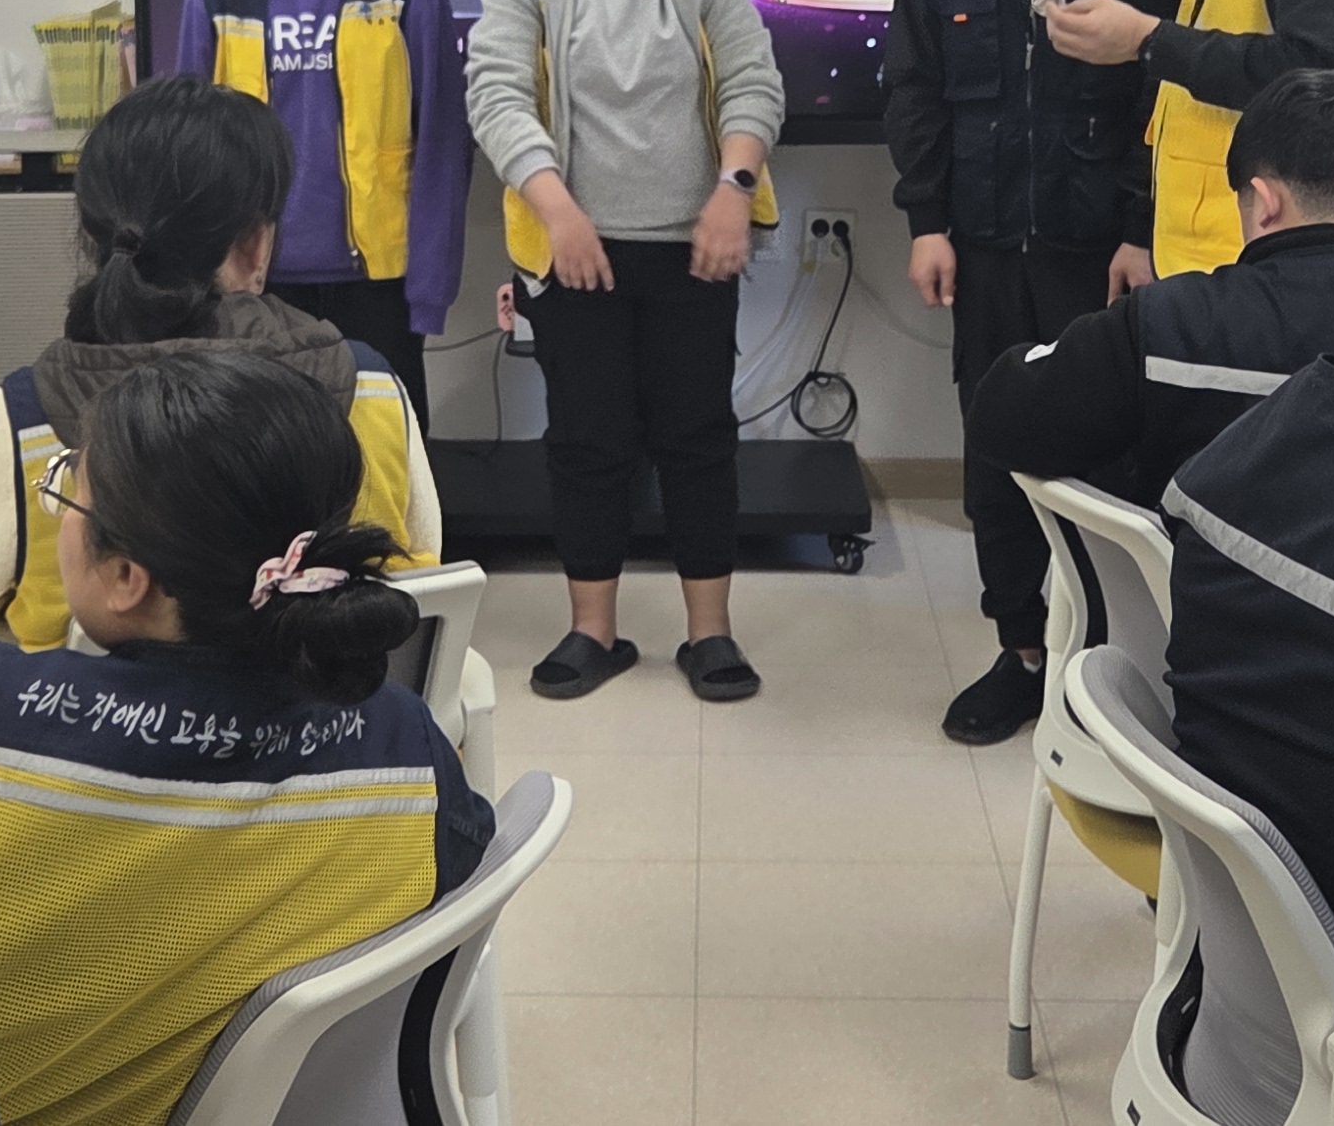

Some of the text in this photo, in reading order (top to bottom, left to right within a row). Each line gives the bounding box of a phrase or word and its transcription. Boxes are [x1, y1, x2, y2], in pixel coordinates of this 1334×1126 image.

[18, 679, 80, 724] 우리는
[85, 692, 167, 744] 장애인
[171, 709, 242, 759] 고용을
[249, 723, 293, 761] 위해
